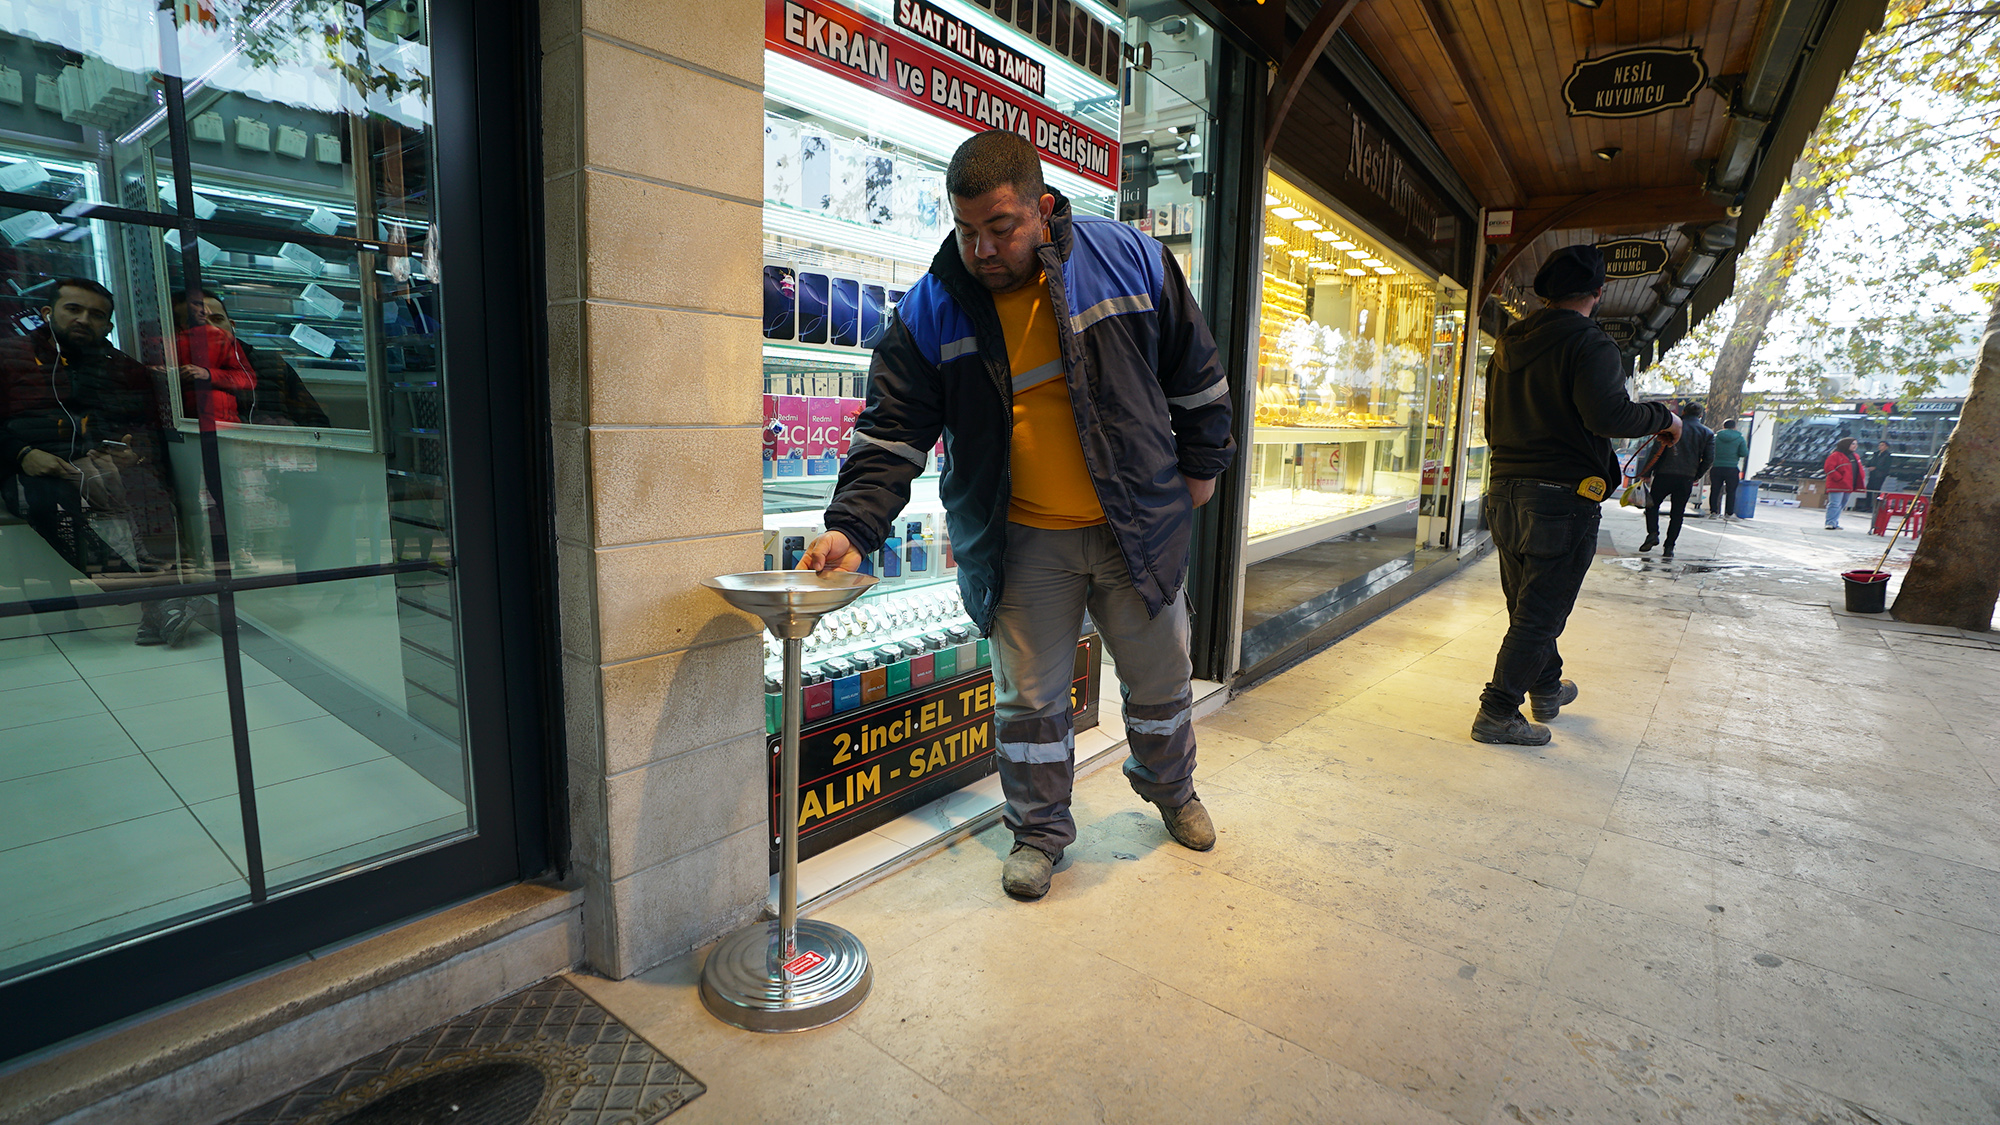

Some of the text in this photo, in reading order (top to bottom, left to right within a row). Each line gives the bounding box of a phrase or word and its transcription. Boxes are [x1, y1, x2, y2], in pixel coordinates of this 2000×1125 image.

[899, 0, 1043, 94] SAAT PİLİ ve TAMİRİ
[1614, 61, 1653, 84] NESİL
[785, 1, 1109, 177] EKRAN ve BATARYA DEĞİŞİMİ
[1595, 85, 1665, 108] KUYUMCU
[1348, 112, 1391, 201] Nesil
[1606, 260, 1647, 273] KUYUMCU
[1614, 245, 1642, 260] BİLİCİ
[812, 415, 832, 423] Redmi
[920, 700, 952, 733] EL
[798, 764, 881, 827] ALIM
[908, 721, 988, 778] SATIM
